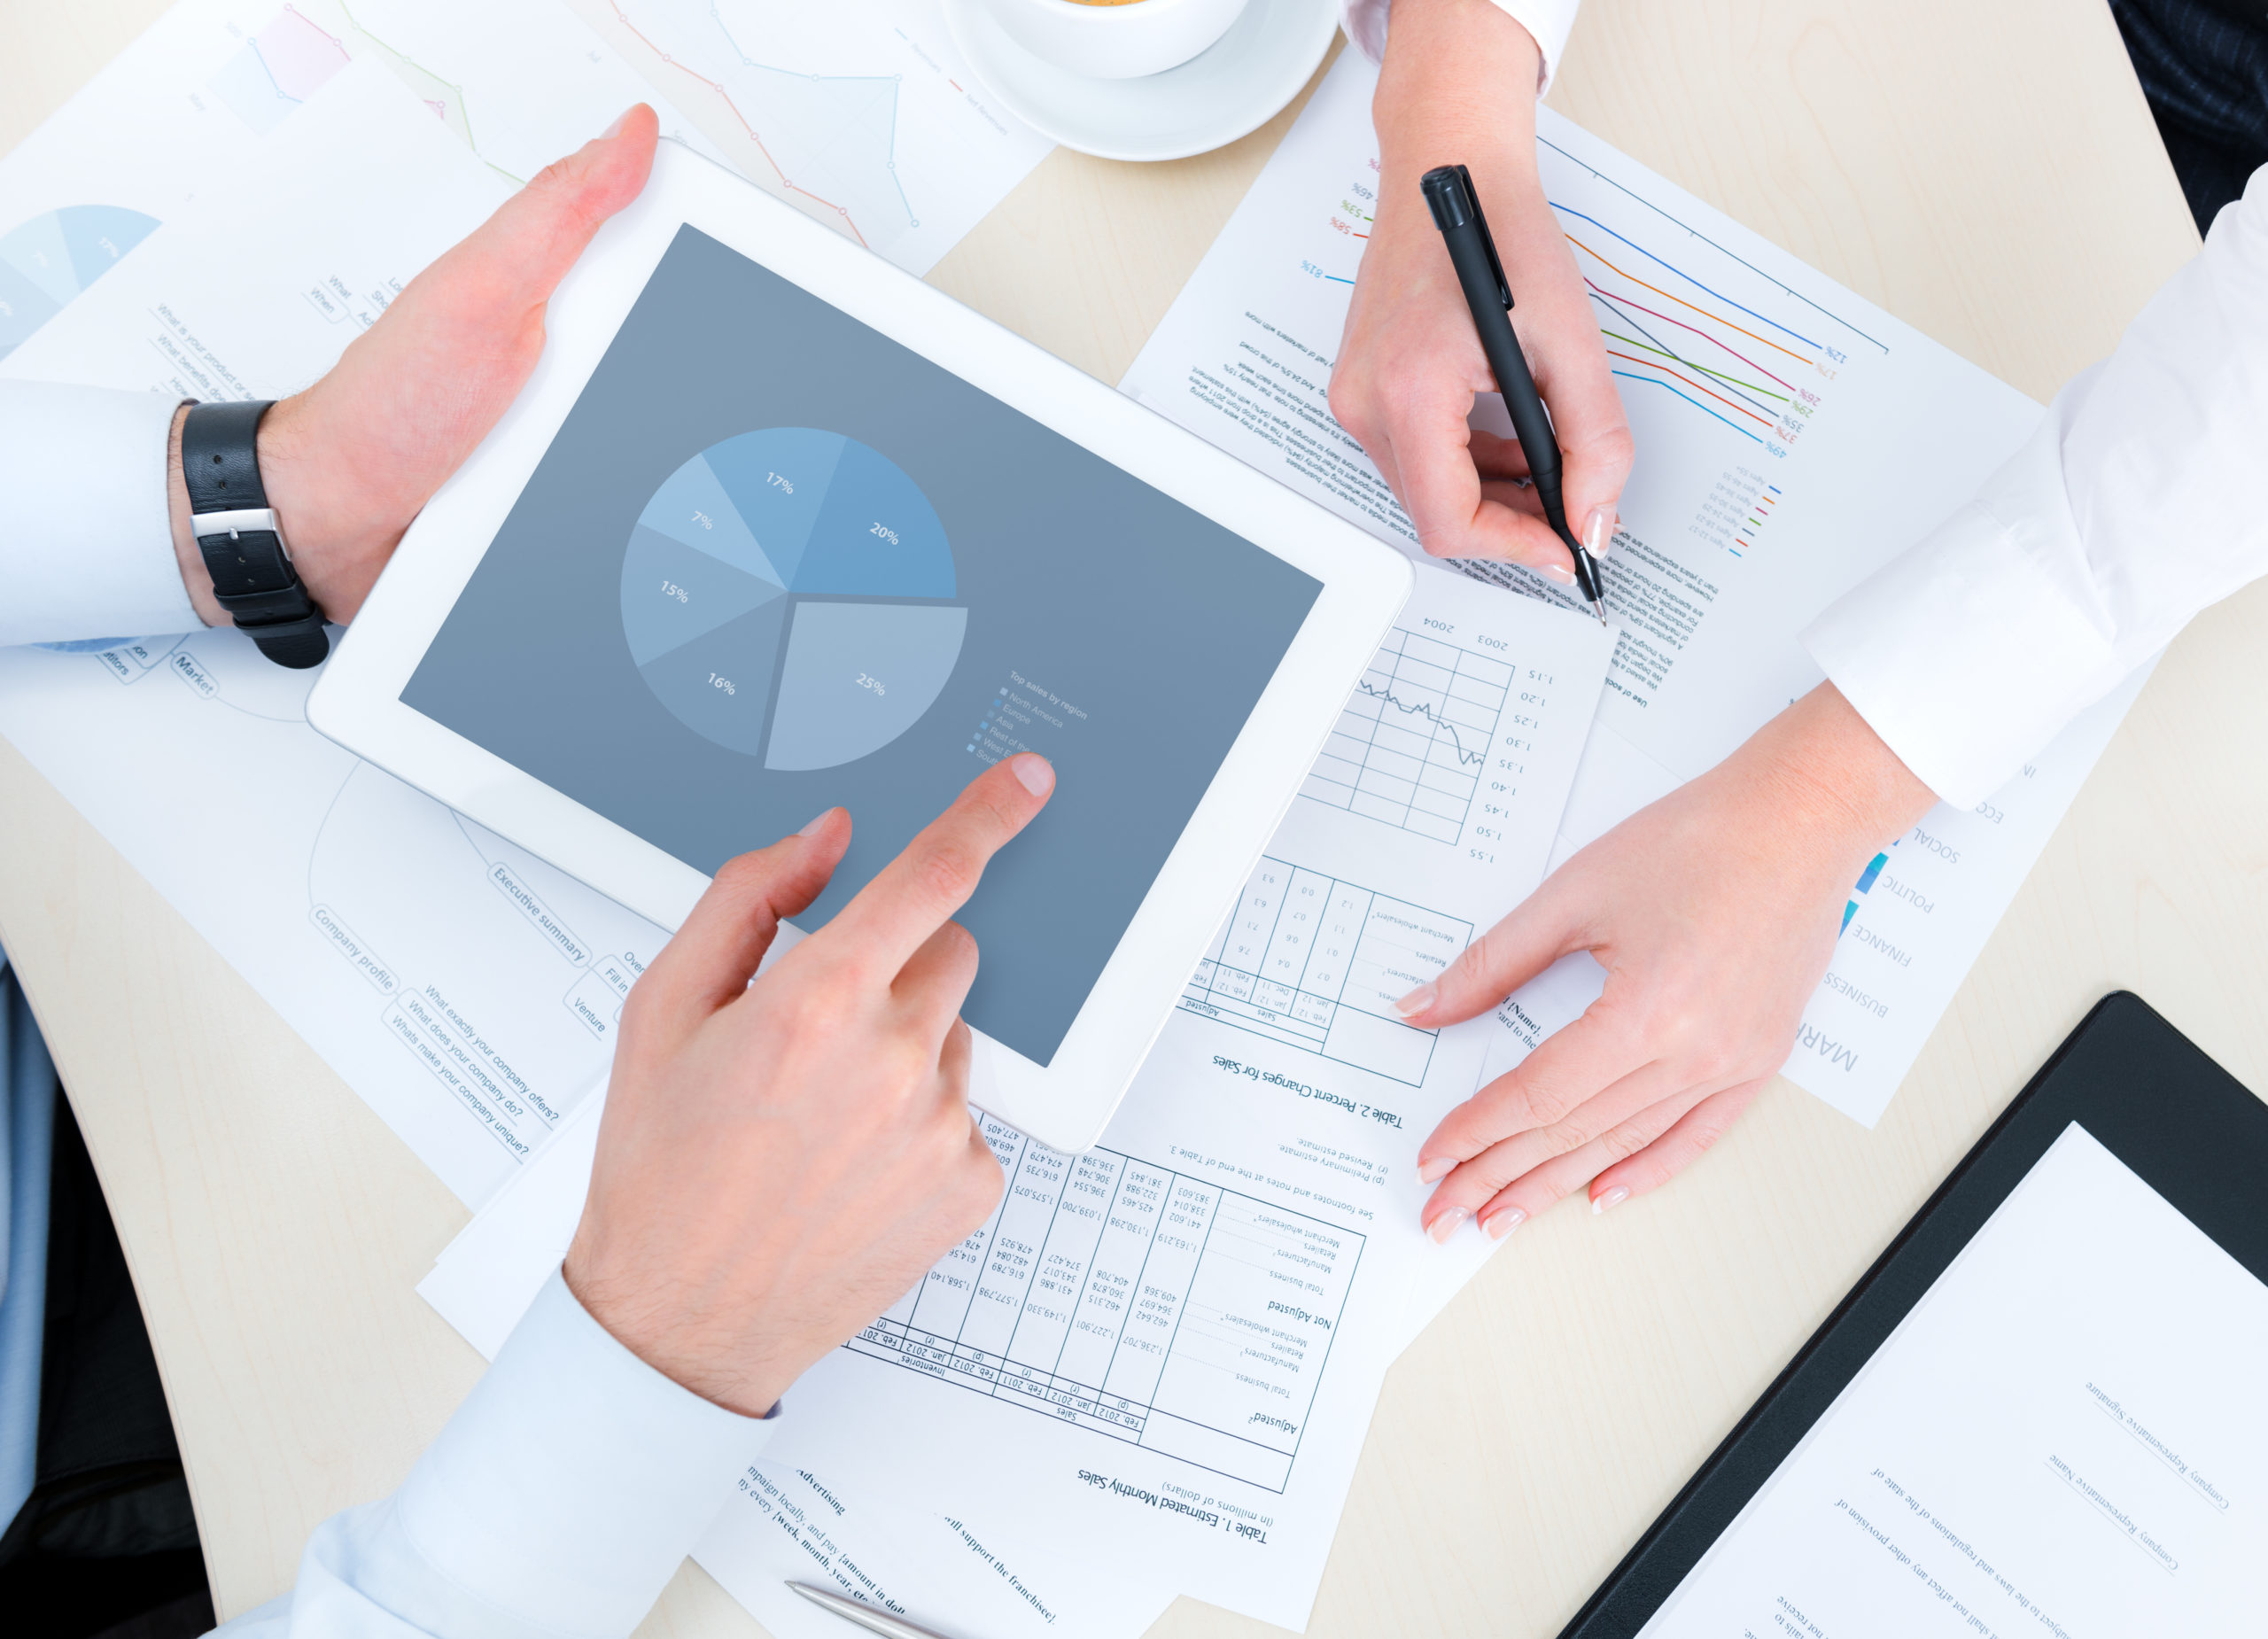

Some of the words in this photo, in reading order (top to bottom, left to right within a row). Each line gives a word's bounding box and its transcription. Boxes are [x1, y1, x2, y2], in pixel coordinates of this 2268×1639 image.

[1351, 182, 1373, 200] 46%
[1340, 199, 1363, 218] 53%
[1330, 216, 1351, 235] 58%
[1301, 260, 1323, 278] 81%
[328, 275, 352, 299] What
[310, 289, 334, 313] When
[158, 305, 180, 327] What
[185, 334, 206, 353] your
[203, 352, 237, 384] product
[235, 382, 245, 392] or
[1239, 340, 1260, 355] crowd
[1826, 346, 1847, 364] 12%
[1300, 378, 1315, 391] And
[1798, 387, 1821, 407] 26%
[1792, 400, 1814, 418] 29%
[1783, 414, 1804, 433] 35%
[1775, 425, 1797, 444] 37%
[1765, 440, 1787, 458] 49%
[766, 471, 793, 494] 17%
[690, 509, 712, 530] 7%
[869, 521, 898, 545] 20%
[661, 579, 688, 603] 15%
[1423, 617, 1455, 633] 2004
[1477, 634, 1508, 651] 2003
[175, 655, 212, 689] Market
[1527, 669, 1553, 685] 1.15
[708, 672, 735, 695] 16%
[855, 672, 885, 695] 25%
[1010, 669, 1025, 685] Top
[1025, 681, 1048, 697] sales
[1048, 692, 1060, 704] by
[1060, 701, 1087, 719] region
[1519, 691, 1545, 707] 1.20
[1632, 694, 1647, 707] Use
[1002, 703, 1030, 724] Europe
[1008, 692, 1030, 710] North
[1030, 705, 1063, 728] America
[995, 715, 1014, 730] Asia
[1513, 714, 1538, 729] 1.25
[989, 726, 1008, 742] Rest
[1505, 736, 1531, 751] 1.30
[983, 737, 1004, 754] West
[1498, 758, 1523, 773] 1.35
[1490, 781, 1516, 796] 1.40
[1484, 803, 1509, 818] 1.45
[1475, 826, 1502, 841] 1.50
[1913, 826, 1961, 864] SOCIAL
[1469, 848, 1494, 864] 1.55
[1881, 874, 1935, 914] POLITIC
[493, 866, 540, 916] Executive
[538, 914, 585, 961] summary
[1419, 926, 1454, 944] Merchant
[1852, 922, 1912, 967] FINANCE
[315, 908, 361, 958] Company
[356, 955, 392, 990] profile
[1415, 951, 1447, 967] Retailers
[604, 967, 621, 983] Fill
[1822, 971, 1889, 1019] BUSINESS
[574, 997, 605, 1032] Venture
[1184, 999, 1219, 1016] Adjusted
[1256, 1008, 1276, 1021] Sales
[1512, 1025, 1523, 1037] to
[1521, 1034, 1536, 1050] the
[408, 998, 432, 1025] What
[429, 1023, 451, 1045] does
[447, 1043, 470, 1064] your
[468, 1062, 506, 1101] company
[503, 1099, 524, 1116] do?
[424, 983, 448, 1010] What
[446, 1008, 476, 1038] exactly
[471, 1036, 494, 1056] your
[492, 1055, 530, 1094] company
[527, 1092, 559, 1121] offers?
[1212, 1054, 1242, 1074] Sales
[1241, 1065, 1260, 1081] for
[392, 1014, 418, 1045] Whats
[416, 1043, 441, 1067] make
[437, 1065, 461, 1086] your
[458, 1084, 496, 1123] company
[493, 1121, 529, 1155] unique?
[1261, 1070, 1312, 1098] Changes
[1312, 1088, 1356, 1113] Percent
[1359, 1103, 1371, 1117] 2.
[1371, 1107, 1402, 1129] Table
[1277, 1143, 1318, 1162] estimate.
[1319, 1156, 1371, 1182] Preliminary
[1371, 1175, 1385, 1186] (p)
[1014, 1185, 1053, 1205] 1,575,075
[1061, 1200, 1101, 1221] 1,039,700
[1157, 1232, 1197, 1253] 1,163,219
[977, 1286, 1018, 1307] 1,577,798
[1026, 1302, 1067, 1324] 1,149,330
[1266, 1300, 1312, 1323] Adjusted
[1076, 1319, 1115, 1340] 1,227,901
[1313, 1315, 1332, 1330] Not
[1122, 1335, 1162, 1355] 1,236,707
[1002, 1375, 1023, 1389] 2011
[1026, 1382, 1043, 1395] Feb.
[1235, 1372, 1270, 1392] business
[1270, 1385, 1290, 1399] Total
[1051, 1391, 1073, 1406] 2012
[1075, 1398, 1091, 1411] Jan.
[2085, 1381, 2126, 1420] Signature
[1056, 1406, 1077, 1421] Sales
[1098, 1407, 1120, 1422] 2012
[1123, 1416, 1139, 1428] Feb.
[2125, 1417, 2188, 1474] Representative
[1869, 1467, 1884, 1479] of
[2048, 1454, 2076, 1480] Name
[1076, 1469, 1108, 1489] Sales
[1884, 1477, 1906, 1496] state
[1107, 1477, 1159, 1507] Monthly
[1161, 1480, 1200, 1503] dollars)
[2189, 1470, 2229, 1510] Company
[1201, 1495, 1215, 1506] of
[1216, 1500, 1258, 1520] millions
[1833, 1498, 1848, 1510] of
[1904, 1495, 1920, 1511] the
[2075, 1477, 2138, 1534] Representative
[1158, 1496, 1219, 1527] Estimated
[1259, 1515, 1273, 1527] (In
[1915, 1507, 1930, 1519] of
[1222, 1517, 1231, 1532] 1.
[1234, 1521, 1267, 1544] Table
[1847, 1507, 1890, 1545] provision
[749, 1489, 771, 1513] every
[771, 1511, 799, 1542] {week,
[800, 1538, 829, 1570] month,
[827, 1567, 852, 1593] year,
[777, 1492, 805, 1526] locally,
[806, 1523, 826, 1541] and
[819, 1538, 837, 1556] pay
[874, 1587, 885, 1600] in
[1930, 1517, 1977, 1561] regulations
[961, 1529, 995, 1564] support
[993, 1561, 1008, 1577] the
[1886, 1543, 1911, 1565] other
[2139, 1530, 2179, 1570] Company
[1912, 1563, 1928, 1581] any
[1974, 1558, 1994, 1575] and
[1926, 1577, 1953, 1603] affect
[1993, 1573, 2015, 1596] laws
[1952, 1600, 1969, 1616] not
[2014, 1592, 2030, 1608] the
[2029, 1605, 2040, 1617] to
[1966, 1613, 1990, 1635] shall
